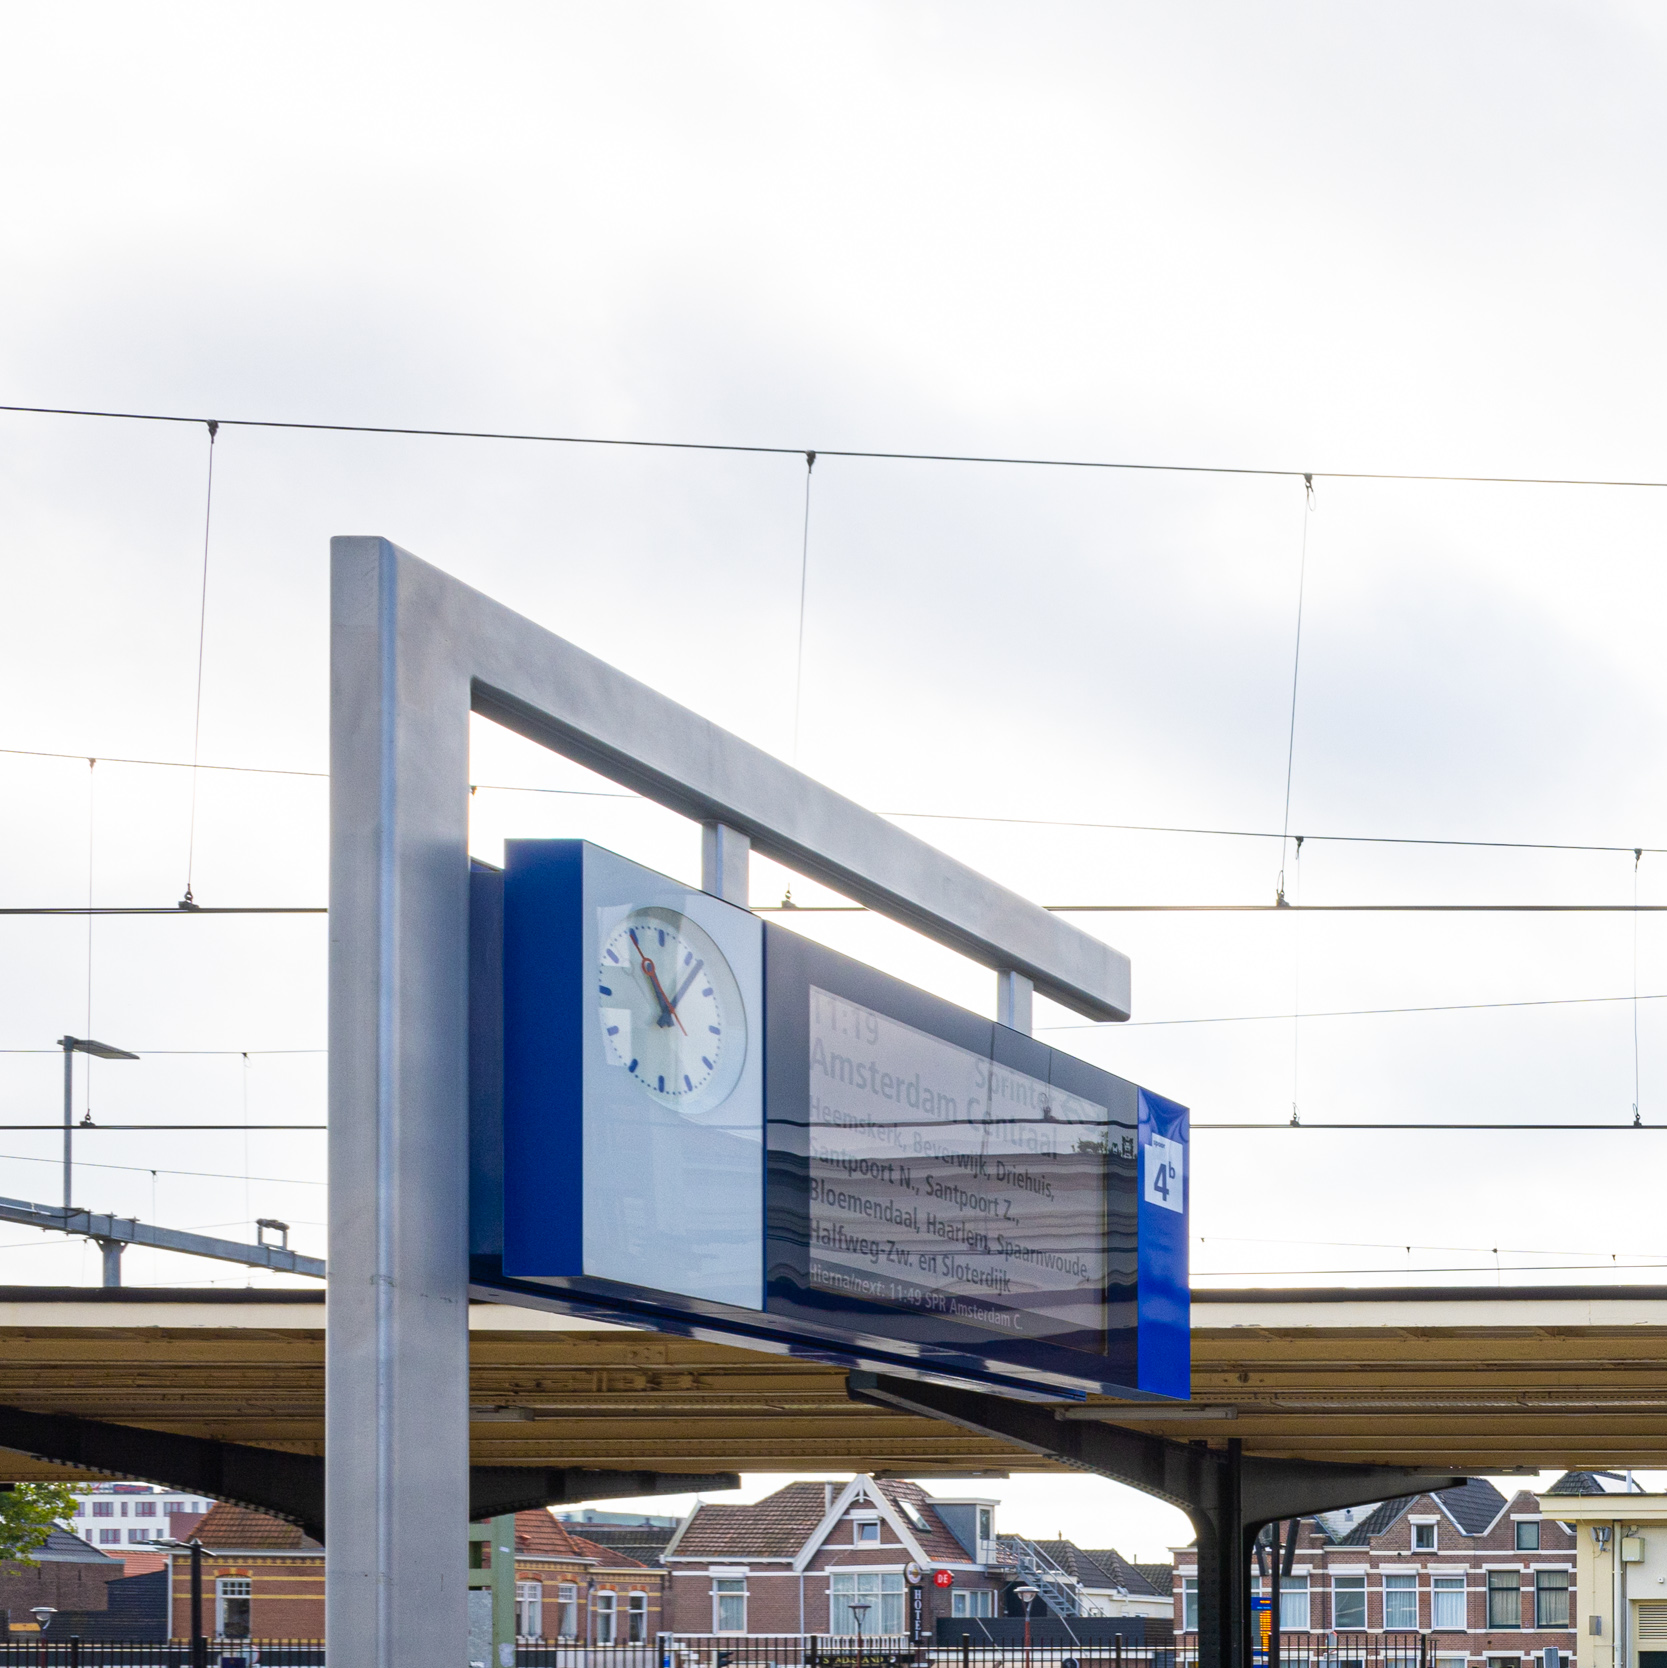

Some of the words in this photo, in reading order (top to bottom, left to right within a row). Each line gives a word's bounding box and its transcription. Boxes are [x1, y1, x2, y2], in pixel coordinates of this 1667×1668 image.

[813, 994, 879, 1046] 11:19
[810, 1036, 957, 1121] Amsterdam
[966, 1096, 1058, 1160] Centraal
[810, 1137, 895, 1184] Santpoort
[925, 1174, 999, 1218] Santpoort
[996, 1160, 1055, 1202] Driehuis,
[810, 1178, 920, 1234] Bloemendaal,
[926, 1211, 991, 1255] Haarlem,
[996, 1233, 1091, 1283] Spaarnwoude,
[810, 1217, 913, 1268] Halfweg-Zw.
[918, 1253, 937, 1274] en
[941, 1254, 1011, 1297] Sloterdijk
[889, 1282, 922, 1307] 11:49
[925, 1291, 947, 1312] SPR
[949, 1298, 1011, 1328] Amsterdam
[937, 1573, 949, 1584] DE
